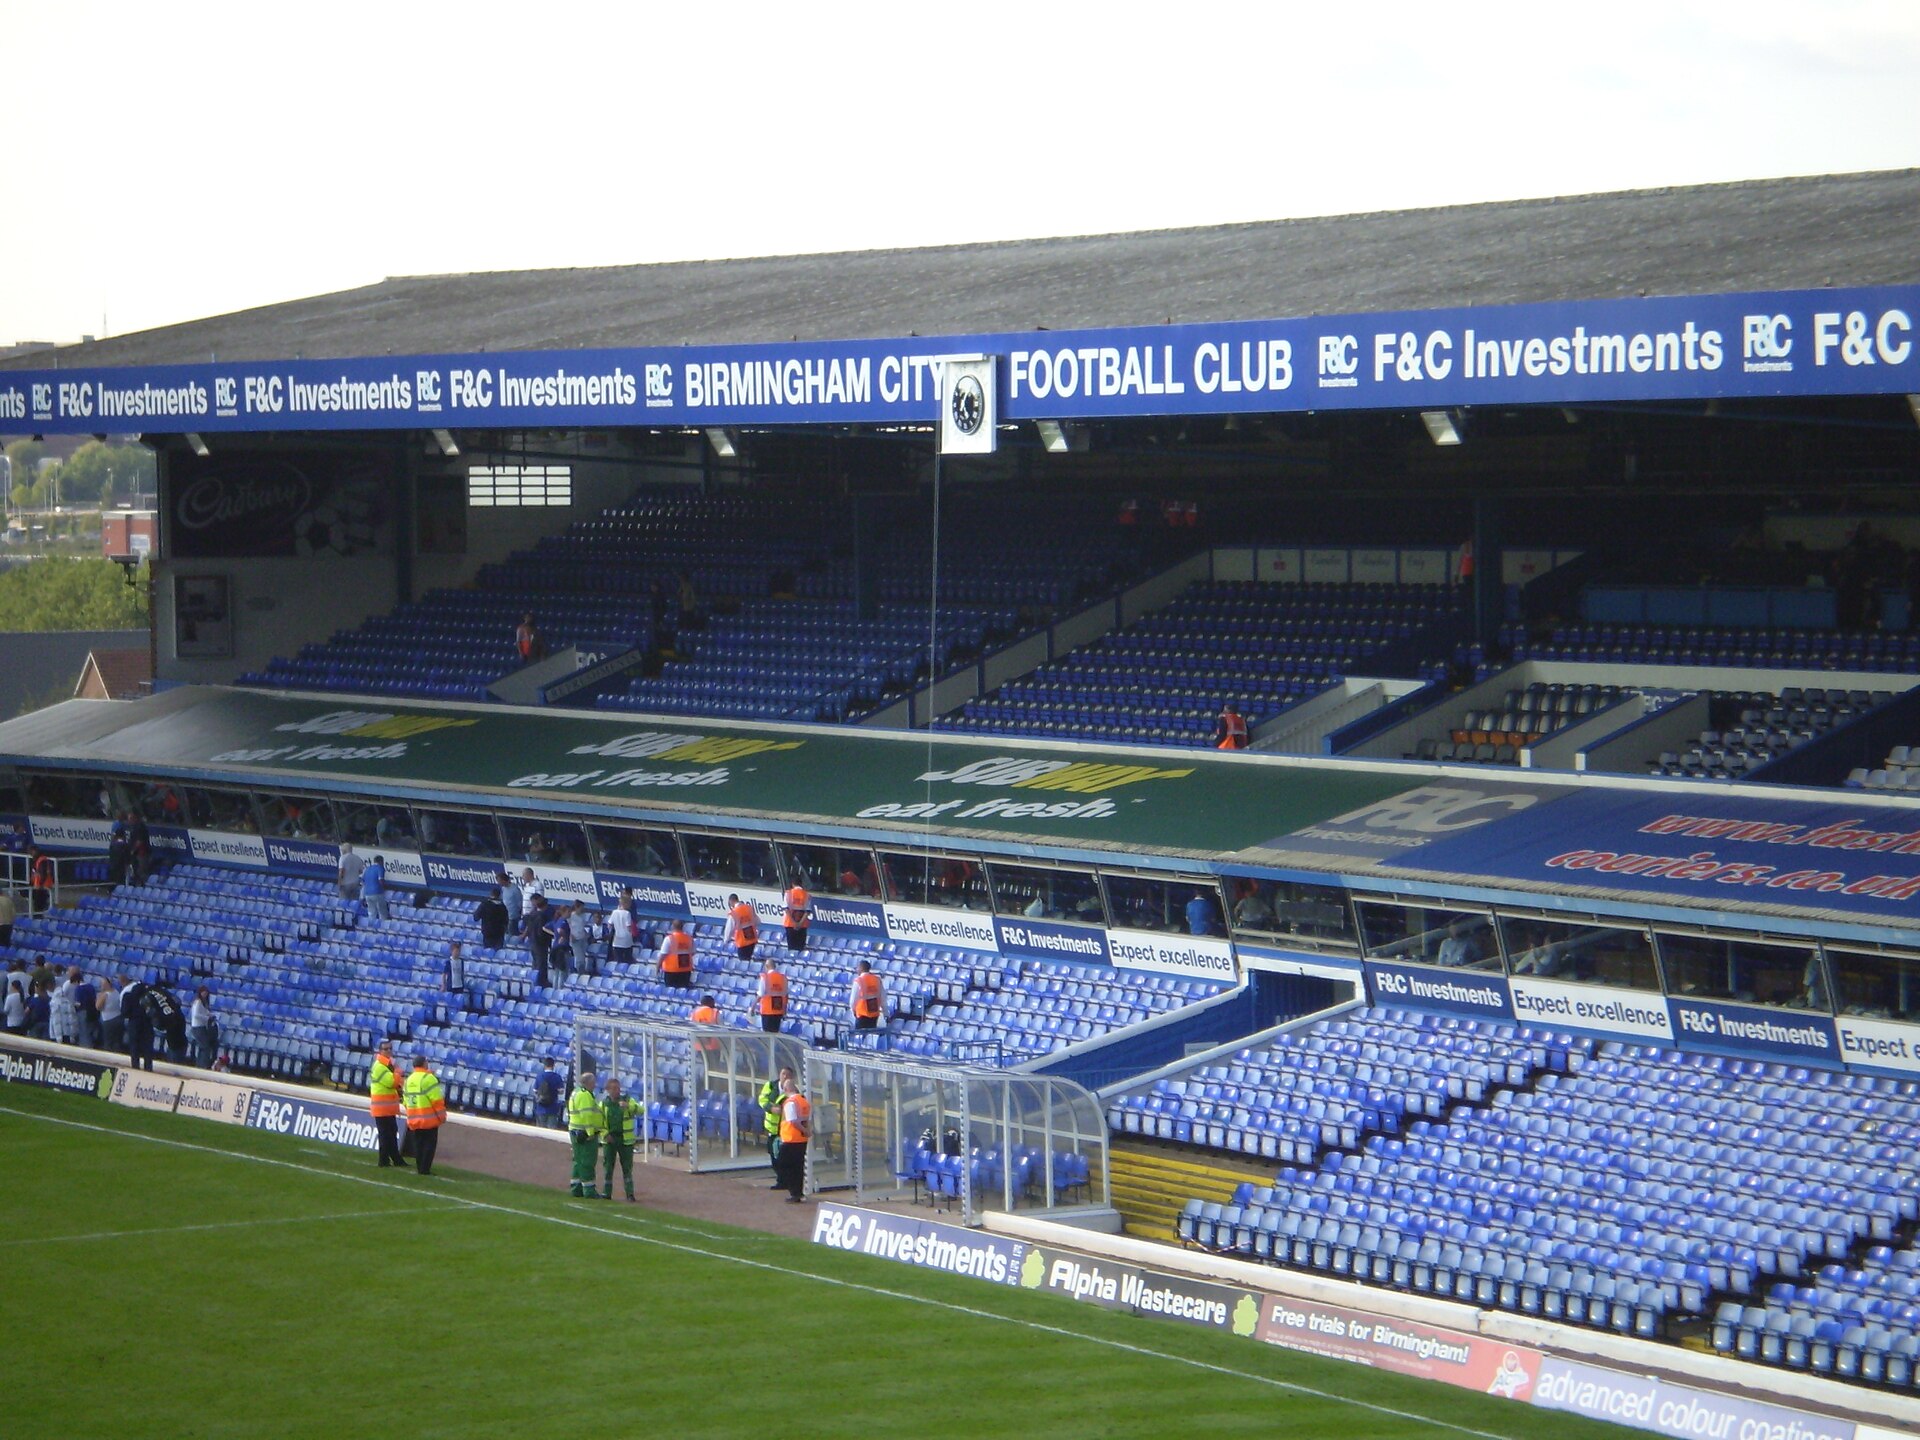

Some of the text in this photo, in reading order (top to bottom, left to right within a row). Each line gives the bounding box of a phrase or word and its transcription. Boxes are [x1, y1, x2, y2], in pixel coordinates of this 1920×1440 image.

[1374, 321, 1723, 382] F&C Investments
[1814, 309, 1912, 366] F&C
[450, 368, 637, 408] F&C Investments
[685, 339, 1293, 407] BIRMINGHAM CITY FOOTBALL CLUB
[59, 381, 208, 417] F&C Investments
[244, 374, 412, 413] F&C Investments
[507, 770, 605, 787] eat
[914, 757, 1196, 793] SUBWAY
[856, 799, 965, 818] eat
[32, 823, 65, 839] Expect
[67, 827, 112, 842] excellenc
[191, 837, 264, 858] Expect excellence
[269, 845, 338, 867] F&C Investments
[384, 859, 423, 876] cellence
[428, 862, 499, 885] F&C Investment
[543, 876, 595, 896] excellence
[601, 881, 621, 898] F&C
[688, 891, 725, 911] Expect
[814, 904, 880, 929] Investments
[887, 913, 993, 942] Expect excellence
[1001, 926, 1102, 956] F&C Investments
[1110, 939, 1231, 971] Expect excellence
[1375, 972, 1503, 1008] F&C Investments
[1514, 989, 1667, 1027] Expect excellence
[1679, 1009, 1829, 1049] F&C Investments
[1841, 1029, 1908, 1058] Expect
[0, 1053, 96, 1090] Alpha Wastecare
[256, 1099, 293, 1132] F&C
[294, 1106, 380, 1150] Investmen
[813, 1209, 861, 1249] F&C
[864, 1219, 1007, 1282] Investments
[1050, 1259, 1117, 1300] Alpha
[1121, 1274, 1226, 1324] Wastecare
[1271, 1306, 1305, 1328] Free
[1308, 1313, 1345, 1336] trials
[1348, 1319, 1372, 1340] for
[1372, 1324, 1470, 1365] Birmingham!
[1536, 1370, 1656, 1421] advanced
[1658, 1393, 1737, 1439] colour
